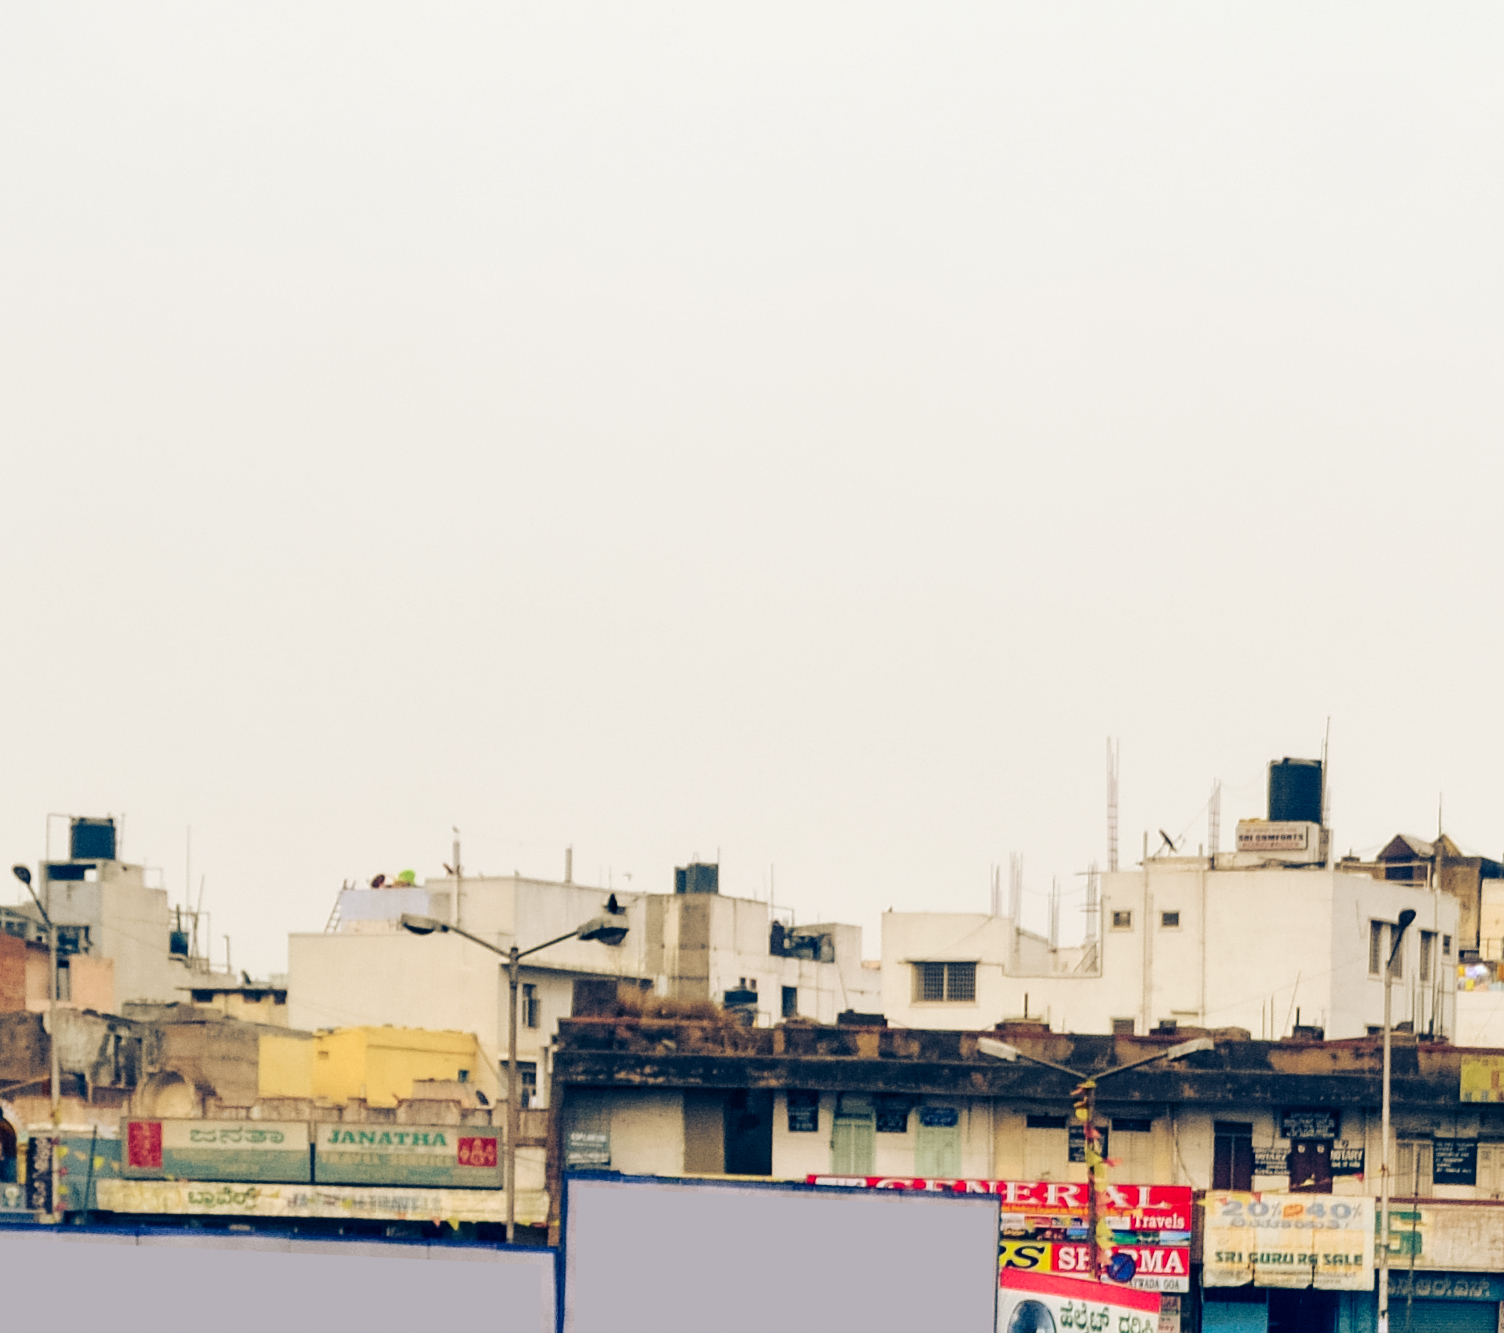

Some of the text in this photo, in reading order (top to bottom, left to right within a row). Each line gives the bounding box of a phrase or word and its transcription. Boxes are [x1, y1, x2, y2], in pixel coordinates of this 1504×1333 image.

[326, 1129, 447, 1148] JANATHA
[1132, 1213, 1186, 1229] Travels
[1215, 1251, 1244, 1263] SRI
[1322, 1253, 1363, 1266] SALE
